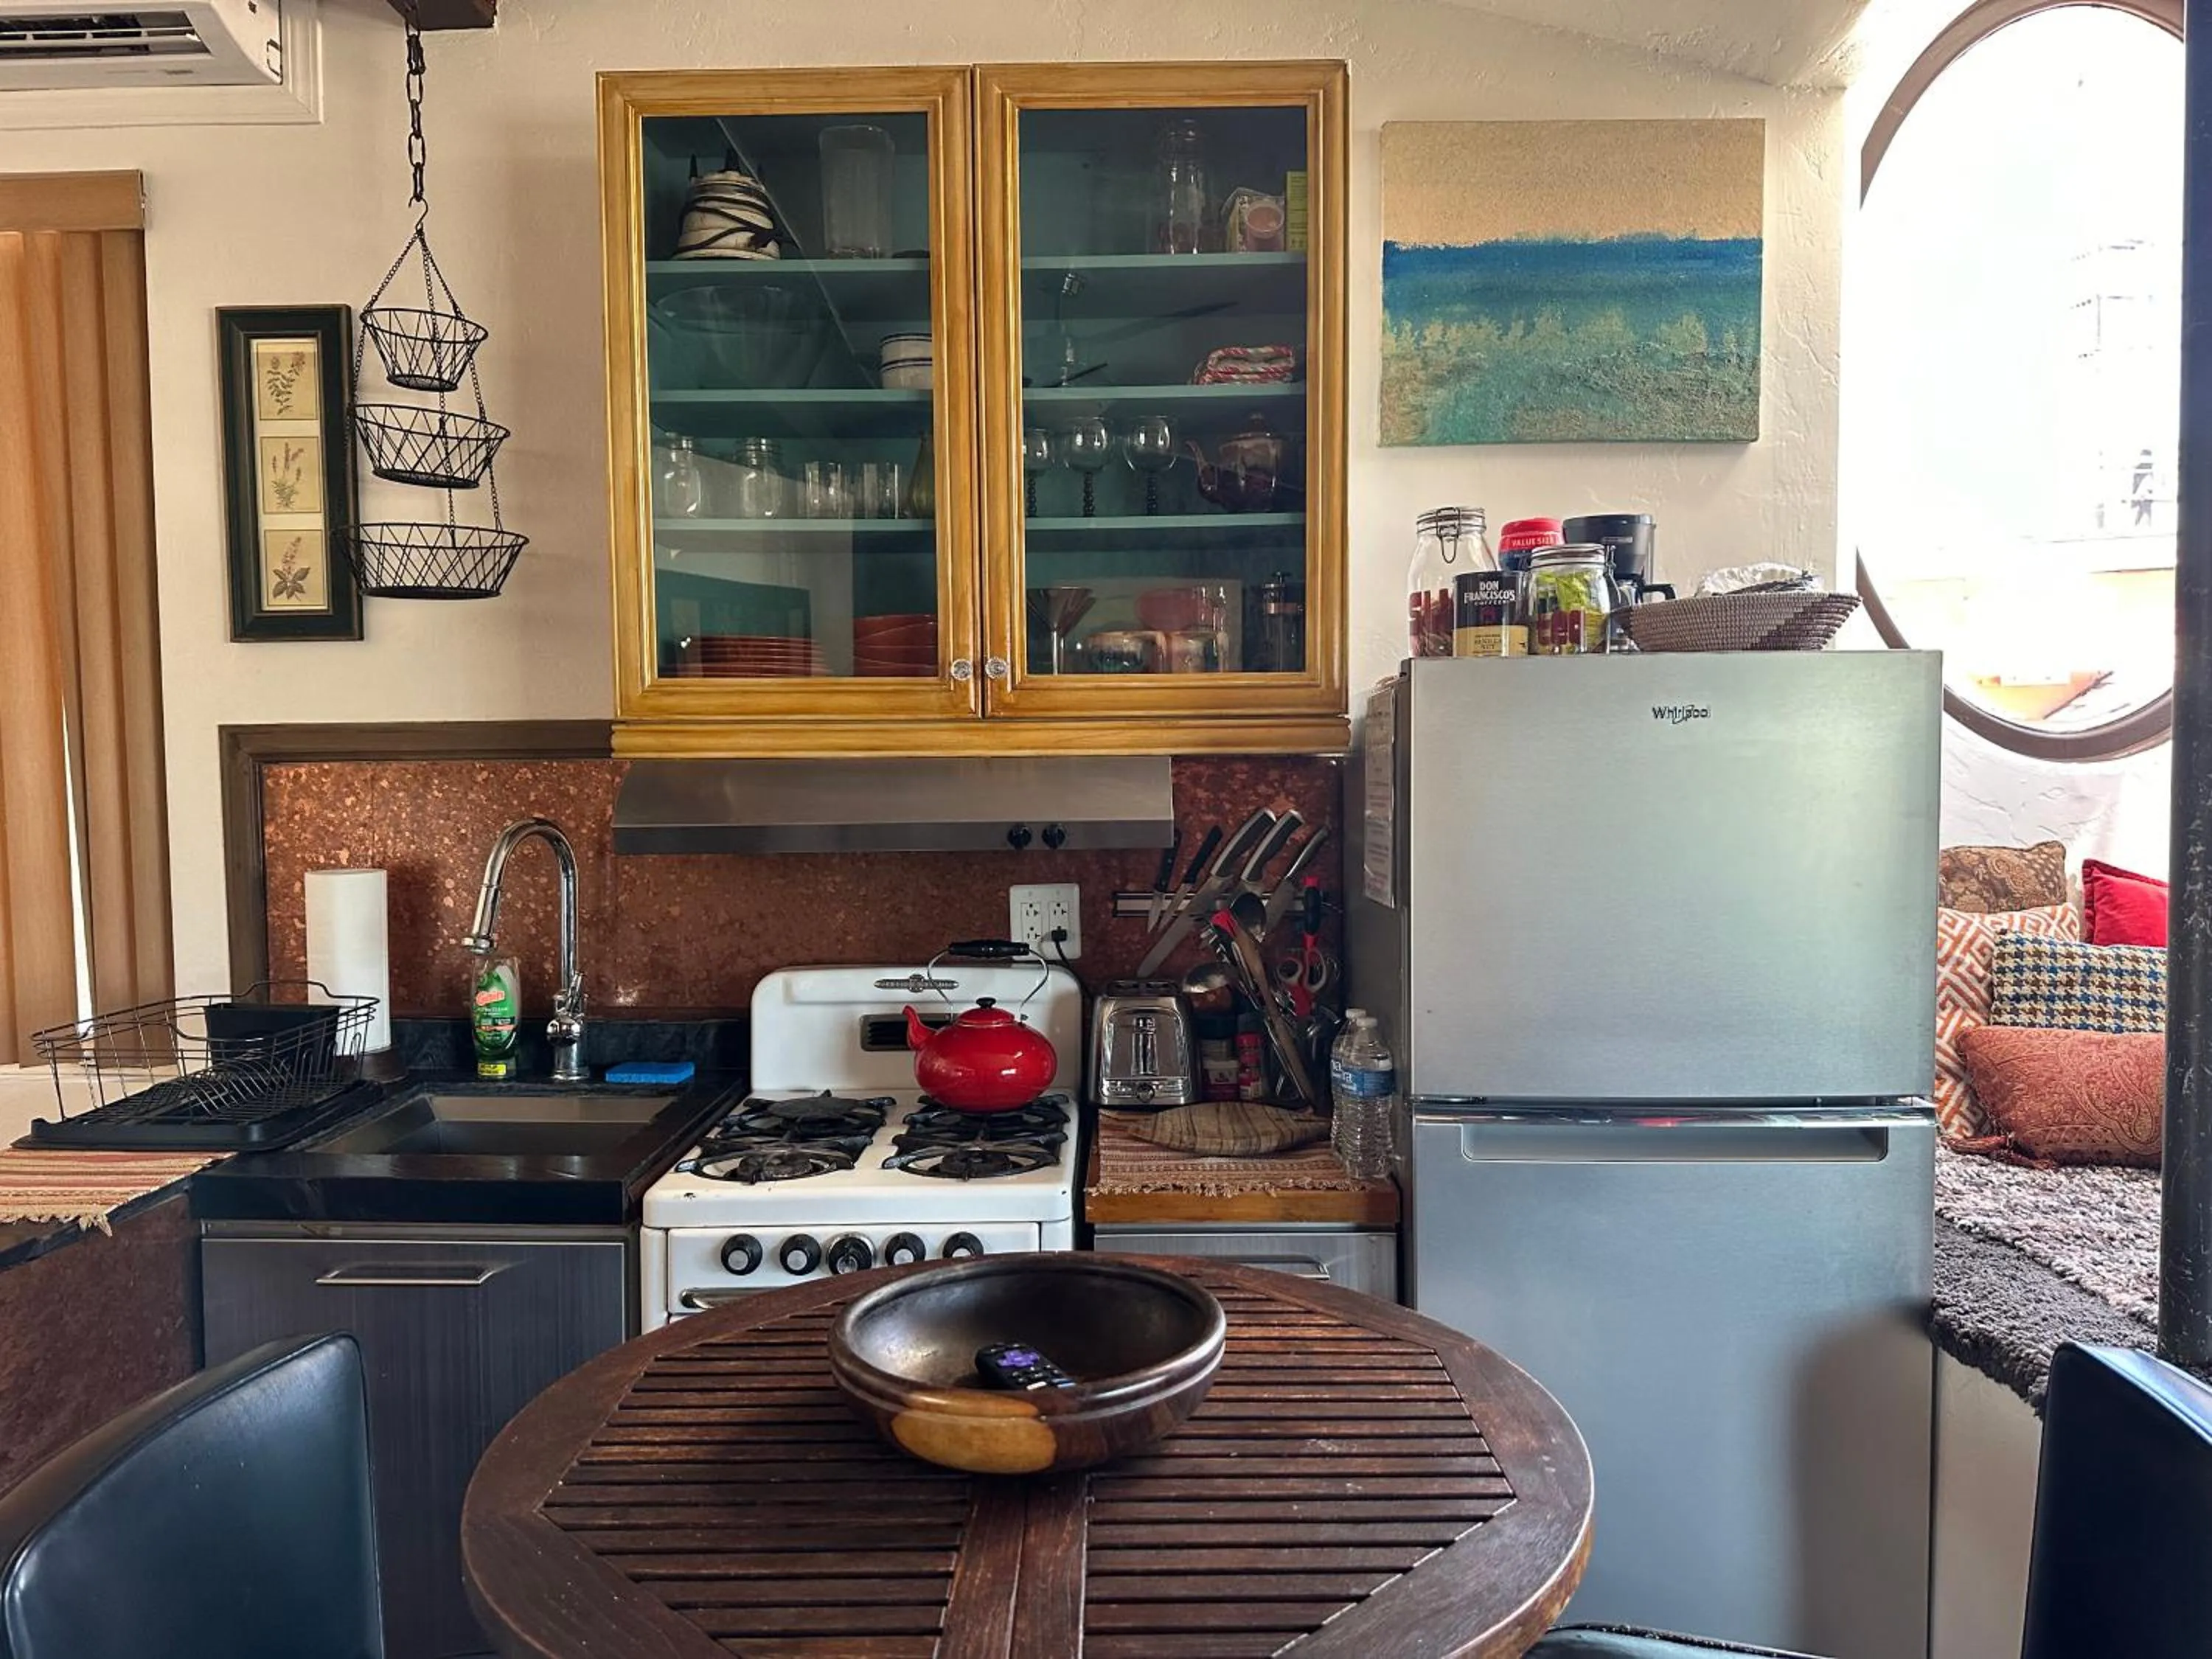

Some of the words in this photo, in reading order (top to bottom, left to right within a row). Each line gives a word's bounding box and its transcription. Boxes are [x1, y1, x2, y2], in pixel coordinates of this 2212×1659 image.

[1512, 538, 1536, 547] VALUE
[1479, 580, 1499, 591] DON
[1464, 589, 1516, 604] FRANCISCO'S
[1652, 704, 1711, 724] Whirlpool
